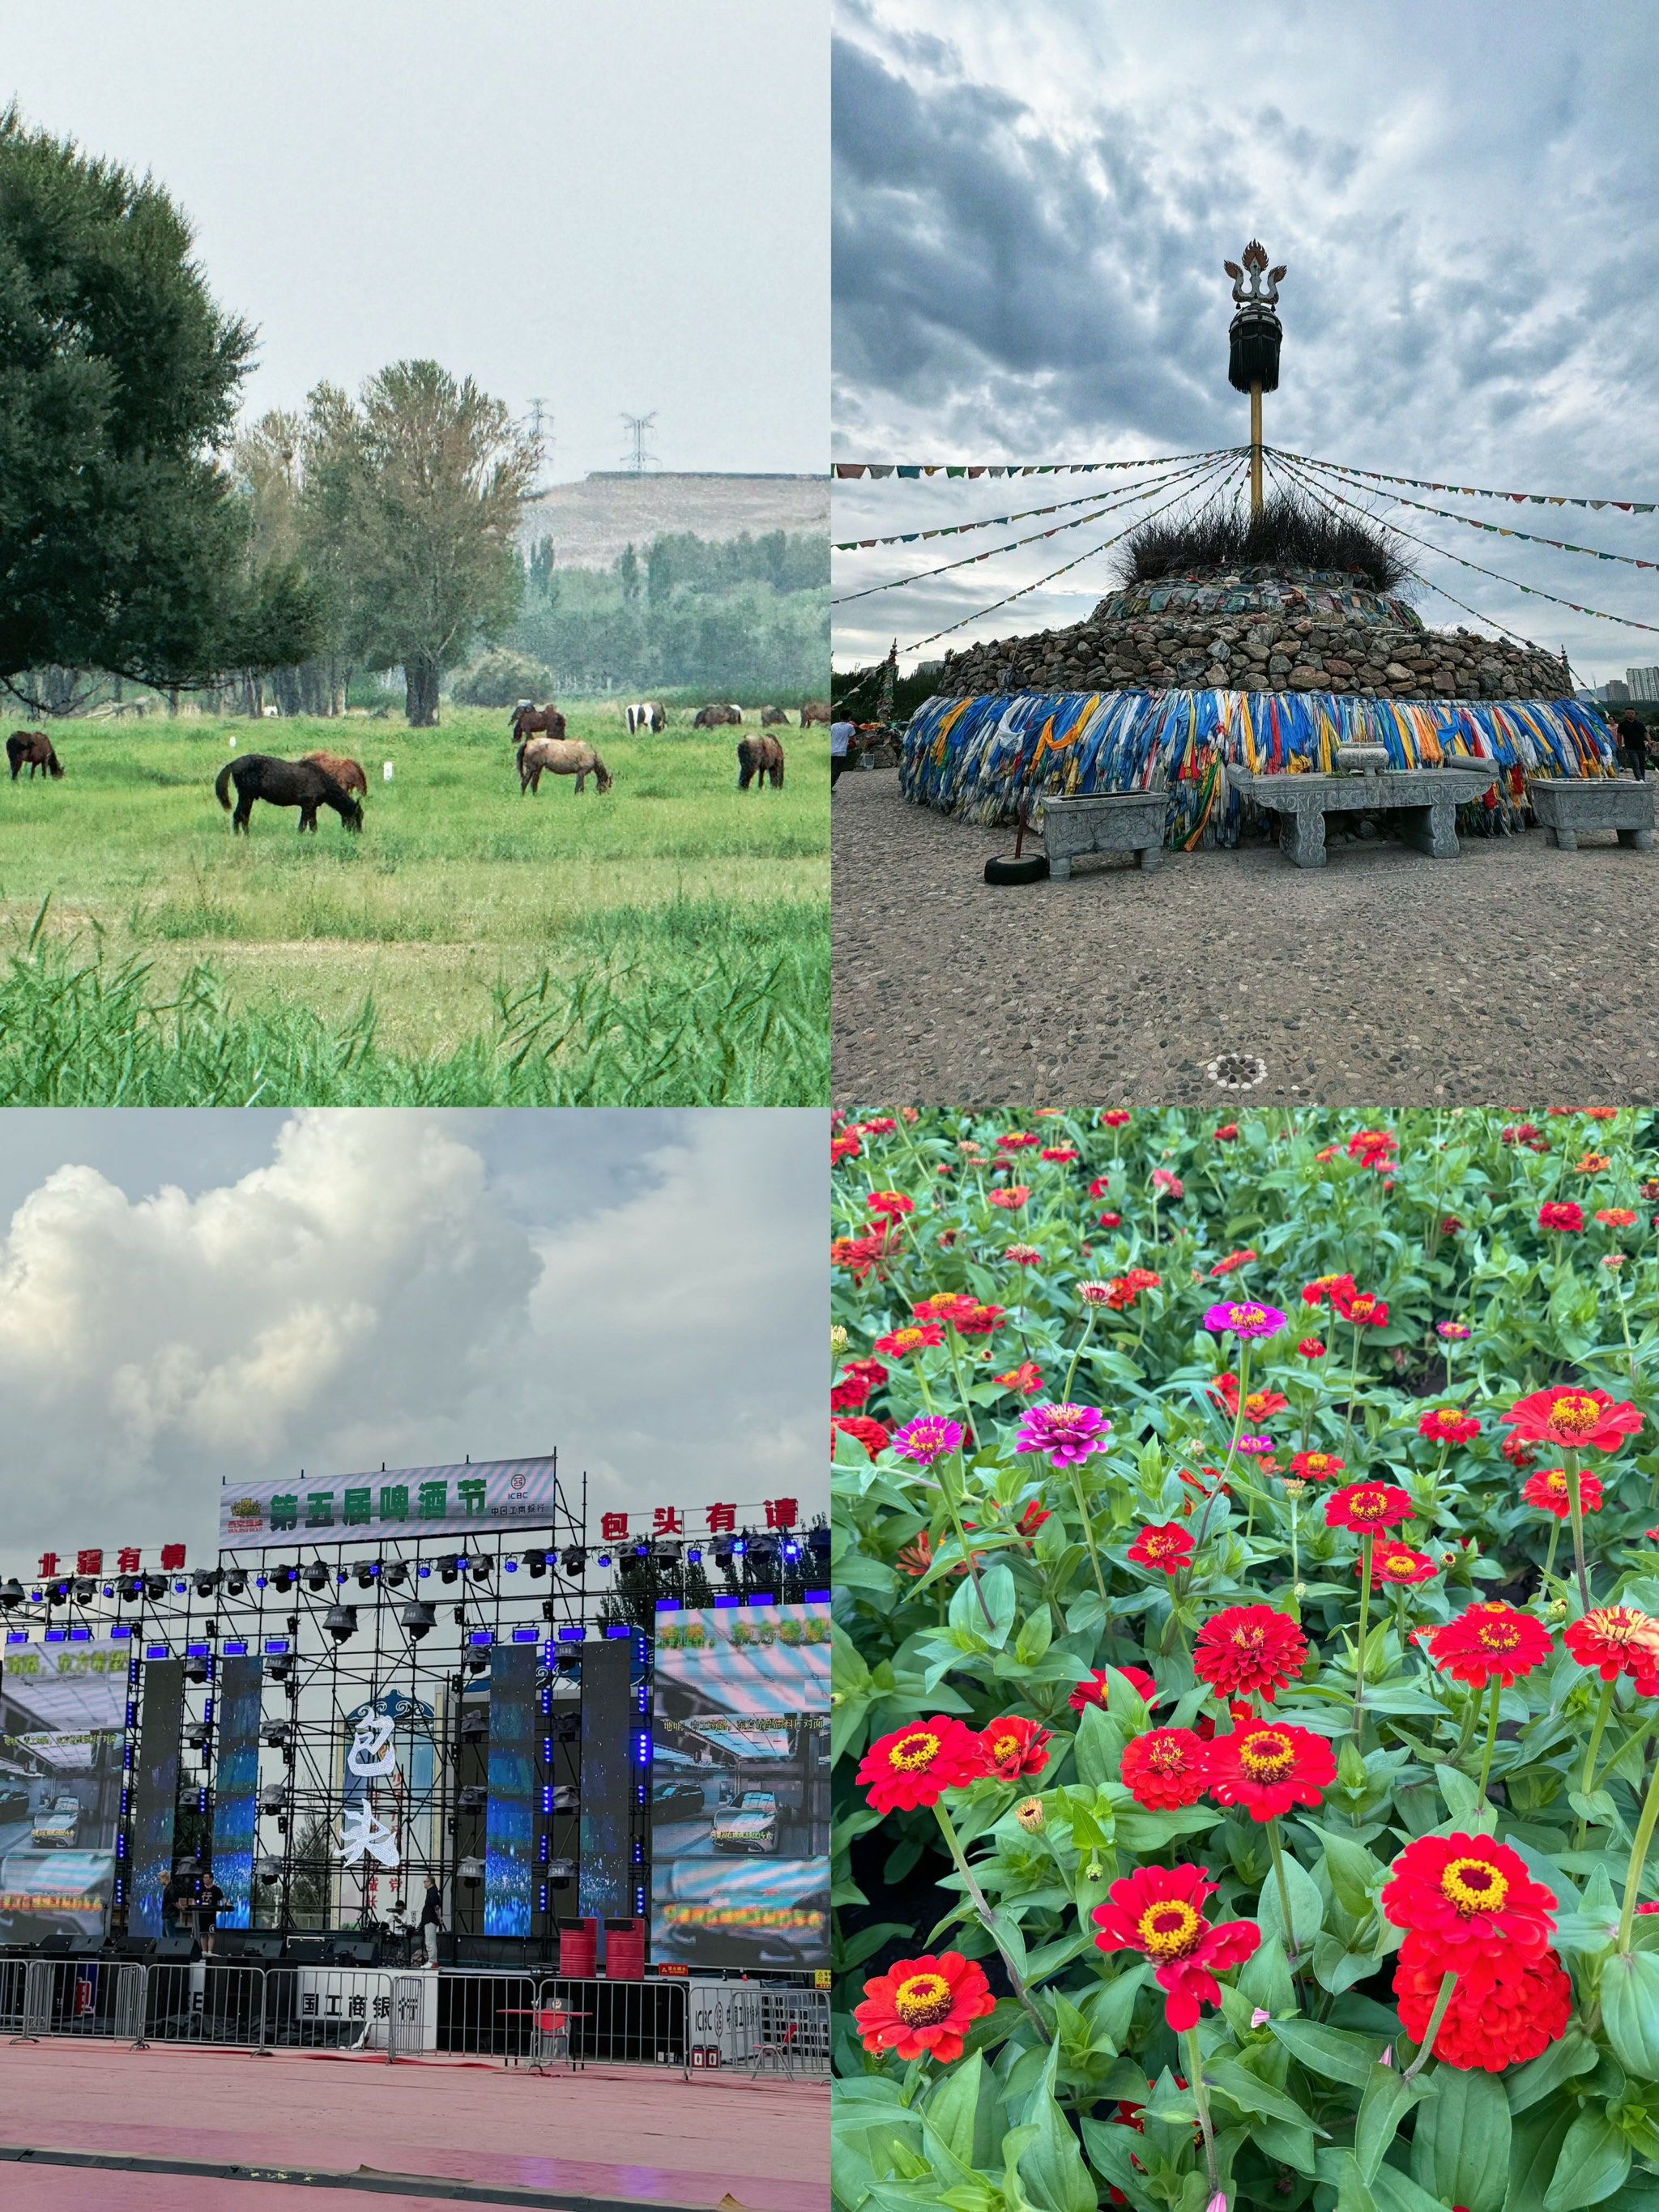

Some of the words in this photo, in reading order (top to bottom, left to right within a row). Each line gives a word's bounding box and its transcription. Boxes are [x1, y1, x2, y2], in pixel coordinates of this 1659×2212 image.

[271, 1479, 487, 1532] 第五届啤酒节
[491, 1503, 545, 1515] 中国工商银行
[508, 1492, 528, 1500] ICBC
[600, 1498, 799, 1541] 包头有请
[37, 1543, 186, 1579] 北疆有情
